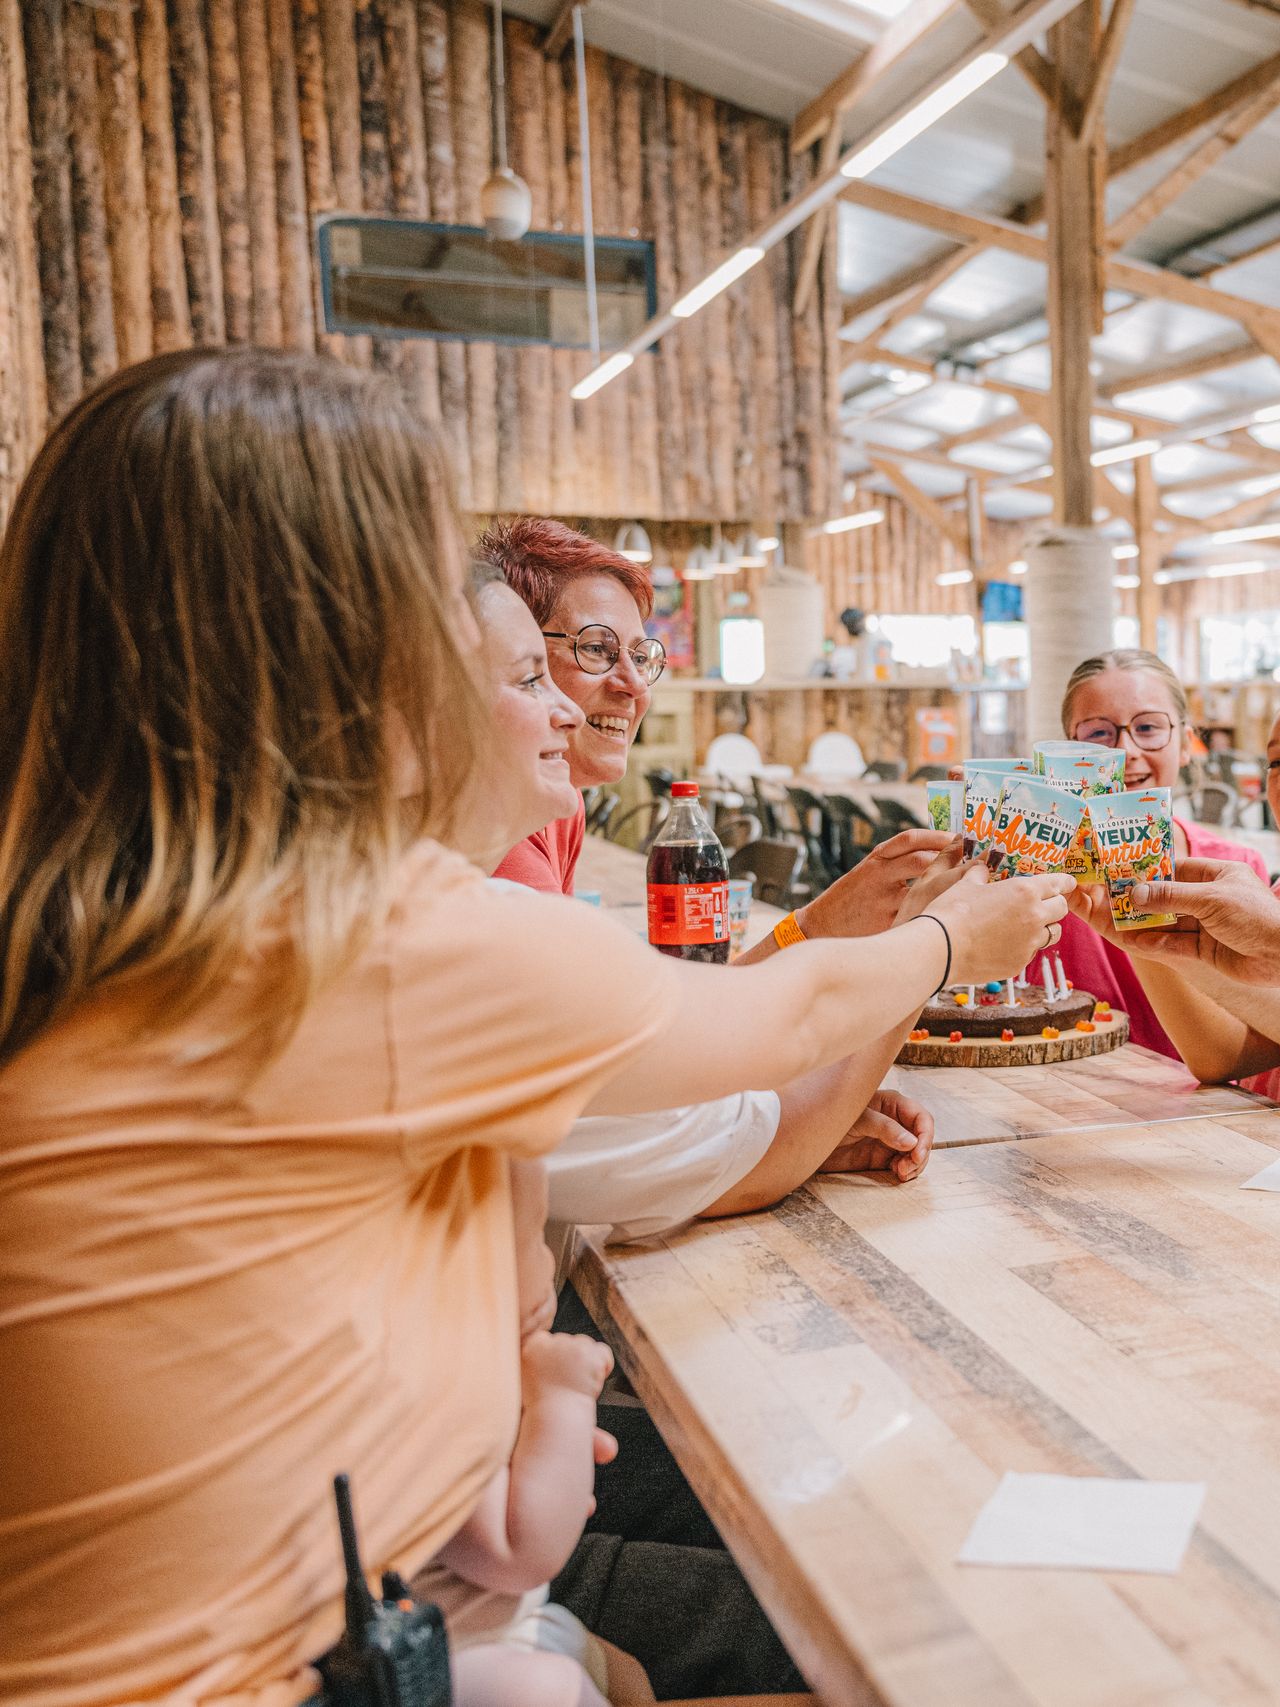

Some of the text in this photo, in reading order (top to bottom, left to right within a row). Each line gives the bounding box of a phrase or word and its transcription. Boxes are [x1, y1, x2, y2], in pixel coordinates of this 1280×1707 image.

[1008, 806, 1026, 816] PARC
[1030, 811, 1041, 820] DE
[1107, 818, 1140, 828] LOISIRS
